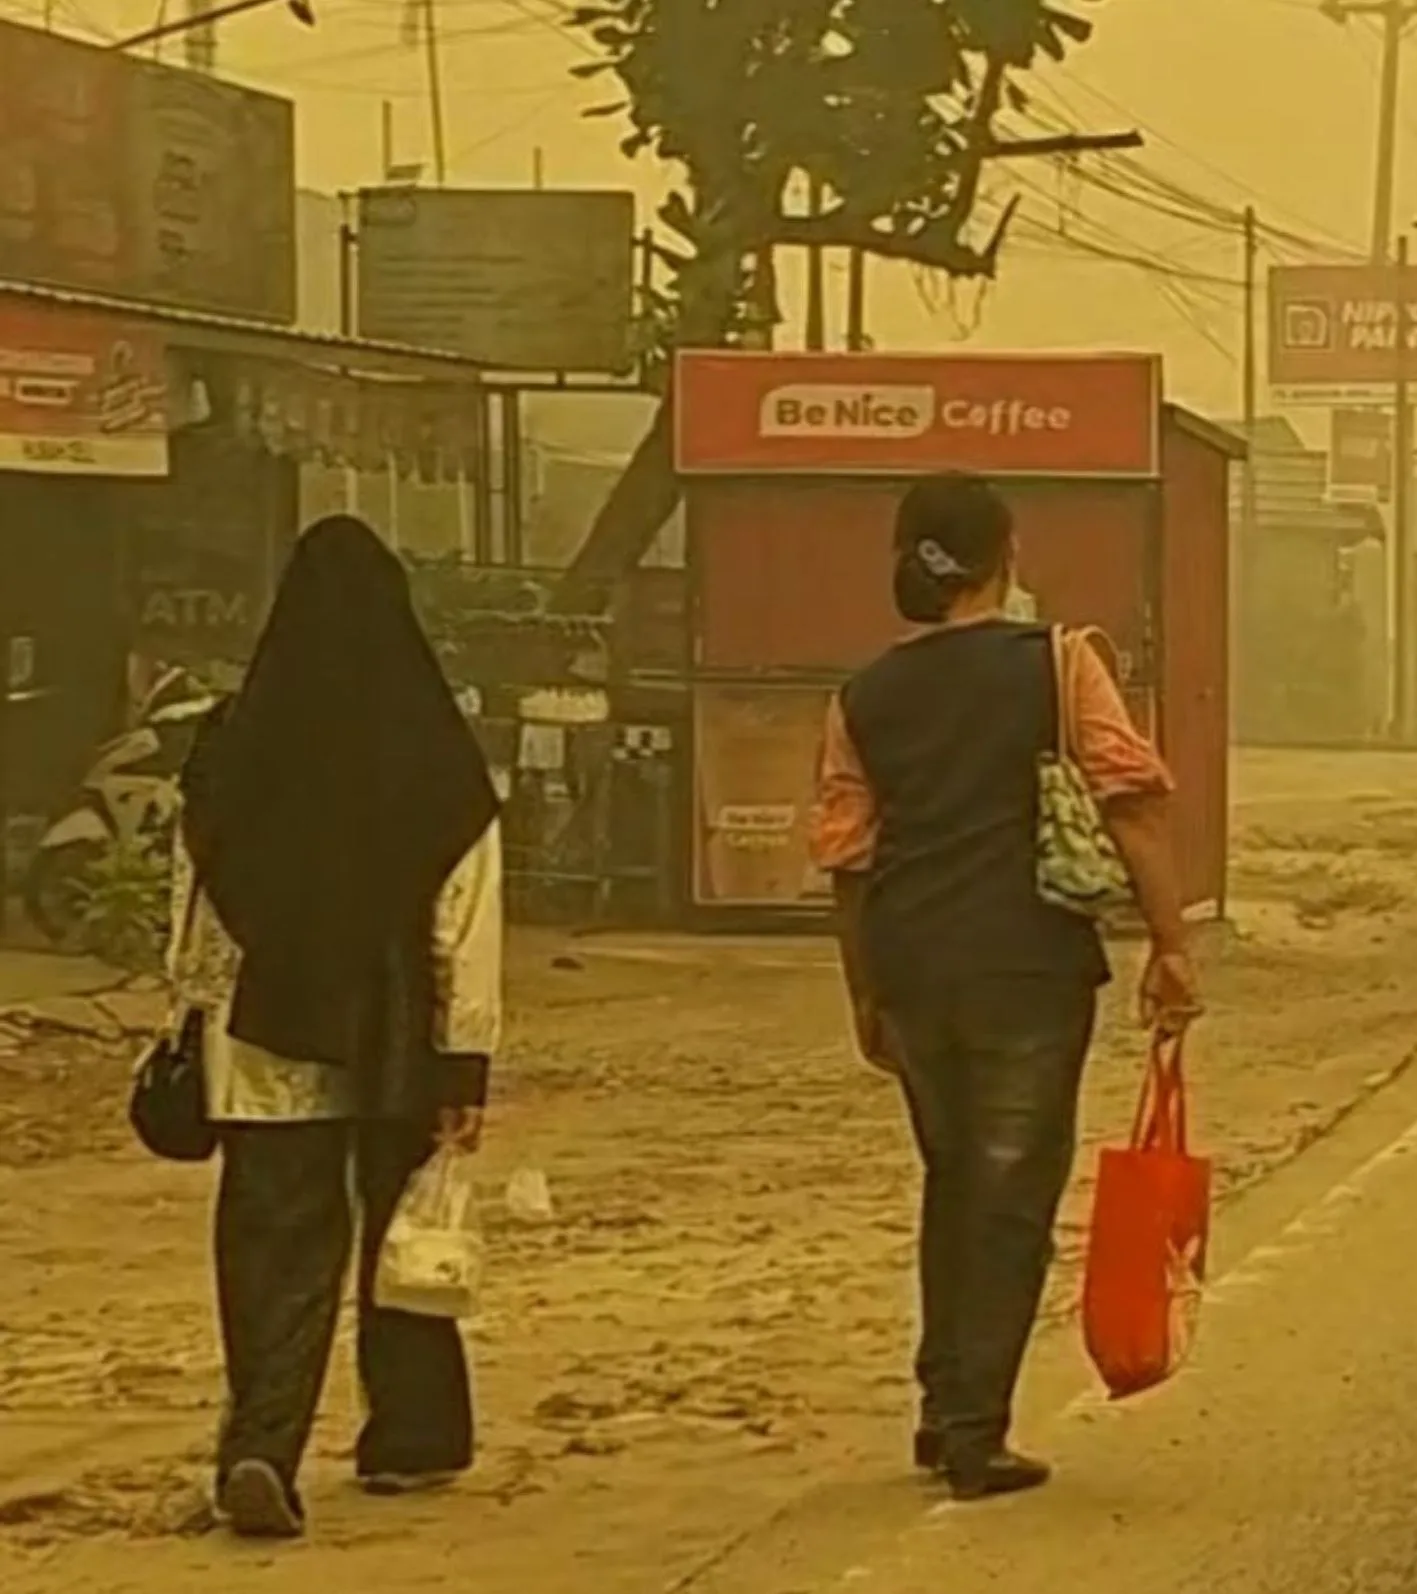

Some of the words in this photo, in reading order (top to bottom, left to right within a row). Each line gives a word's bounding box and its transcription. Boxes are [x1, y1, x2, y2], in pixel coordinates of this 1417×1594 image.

[775, 399, 827, 427] Be
[834, 393, 920, 427] Nice
[941, 399, 1072, 436] Coffee
[141, 589, 248, 625] ATM
